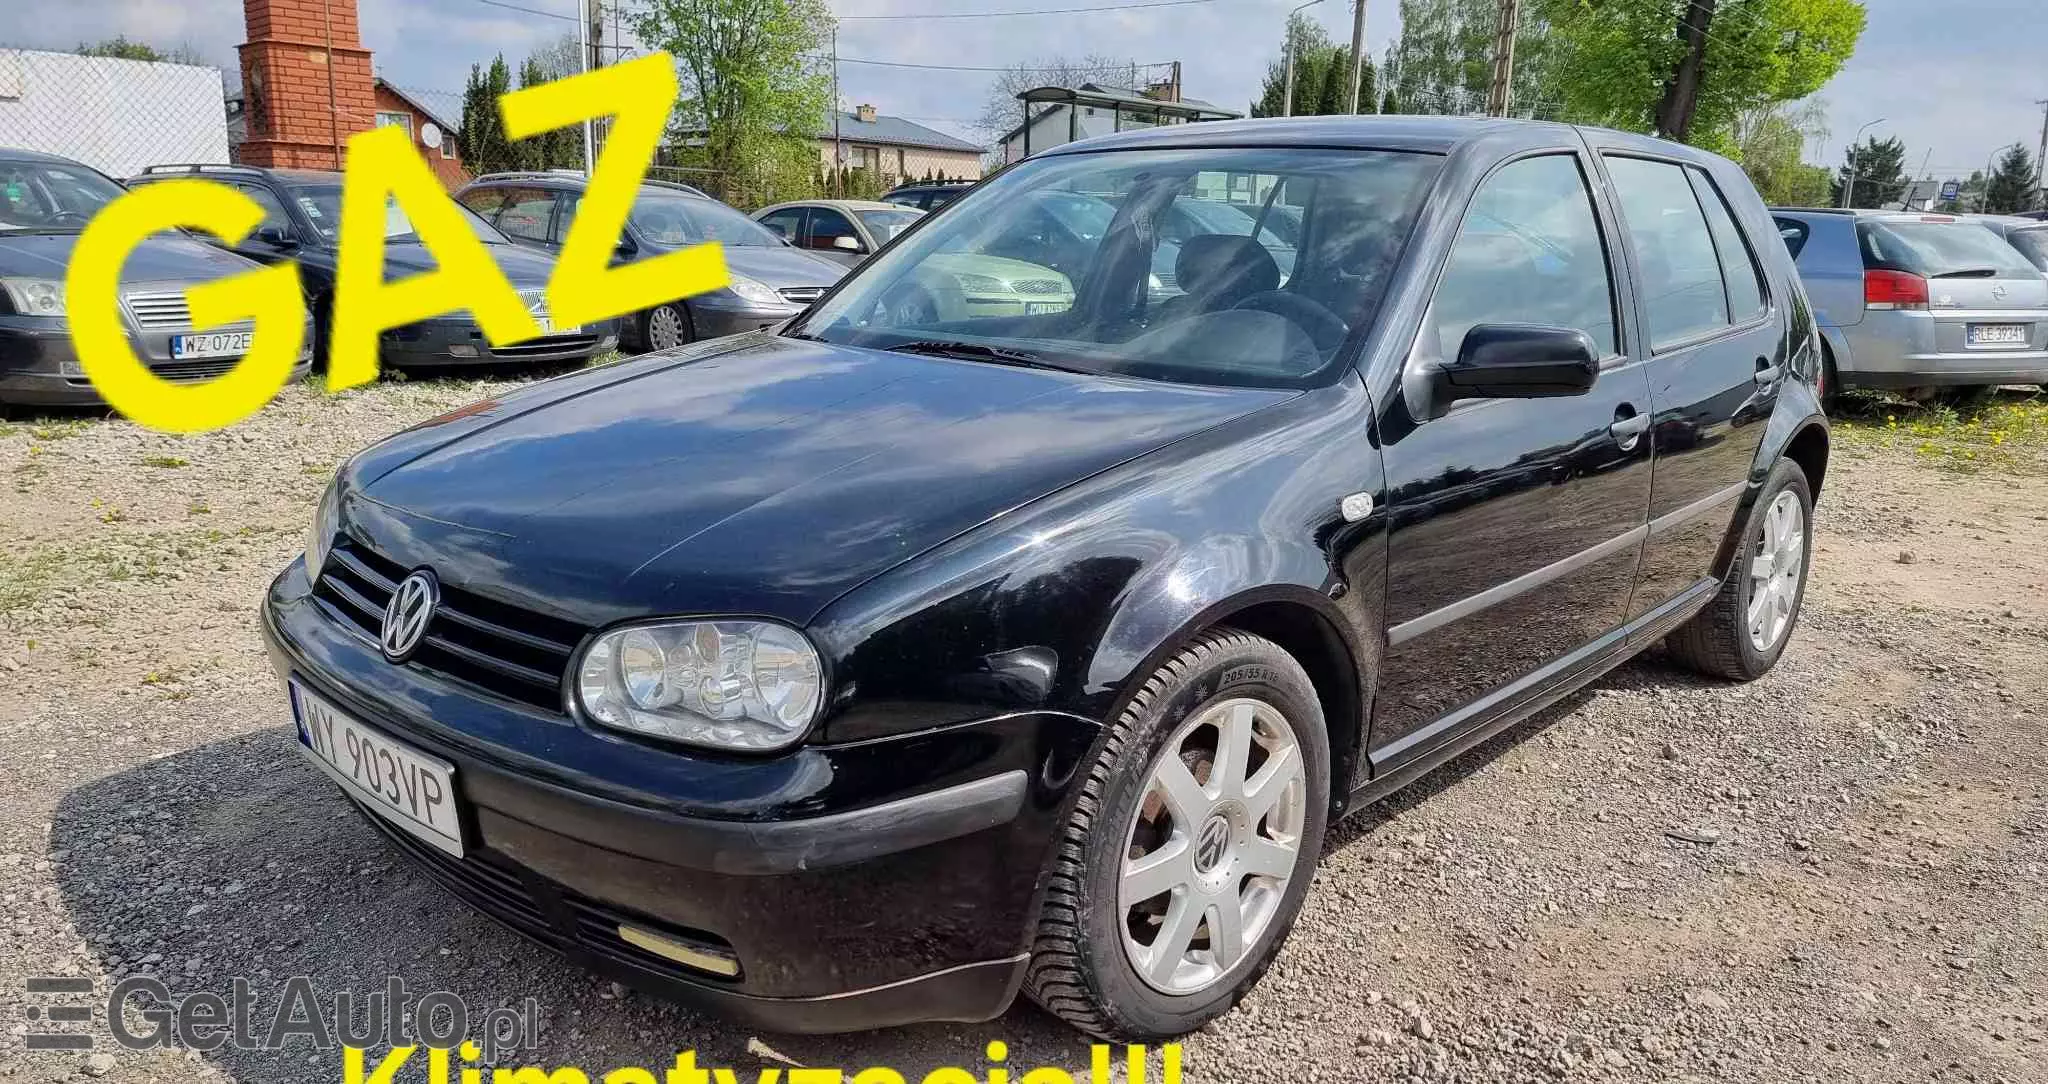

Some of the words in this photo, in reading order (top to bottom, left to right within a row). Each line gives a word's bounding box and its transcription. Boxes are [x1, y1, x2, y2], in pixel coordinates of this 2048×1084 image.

[185, 336, 208, 352] WZ
[212, 332, 255, 351] 072E
[304, 695, 337, 764] WY
[345, 727, 443, 825] 903VP
